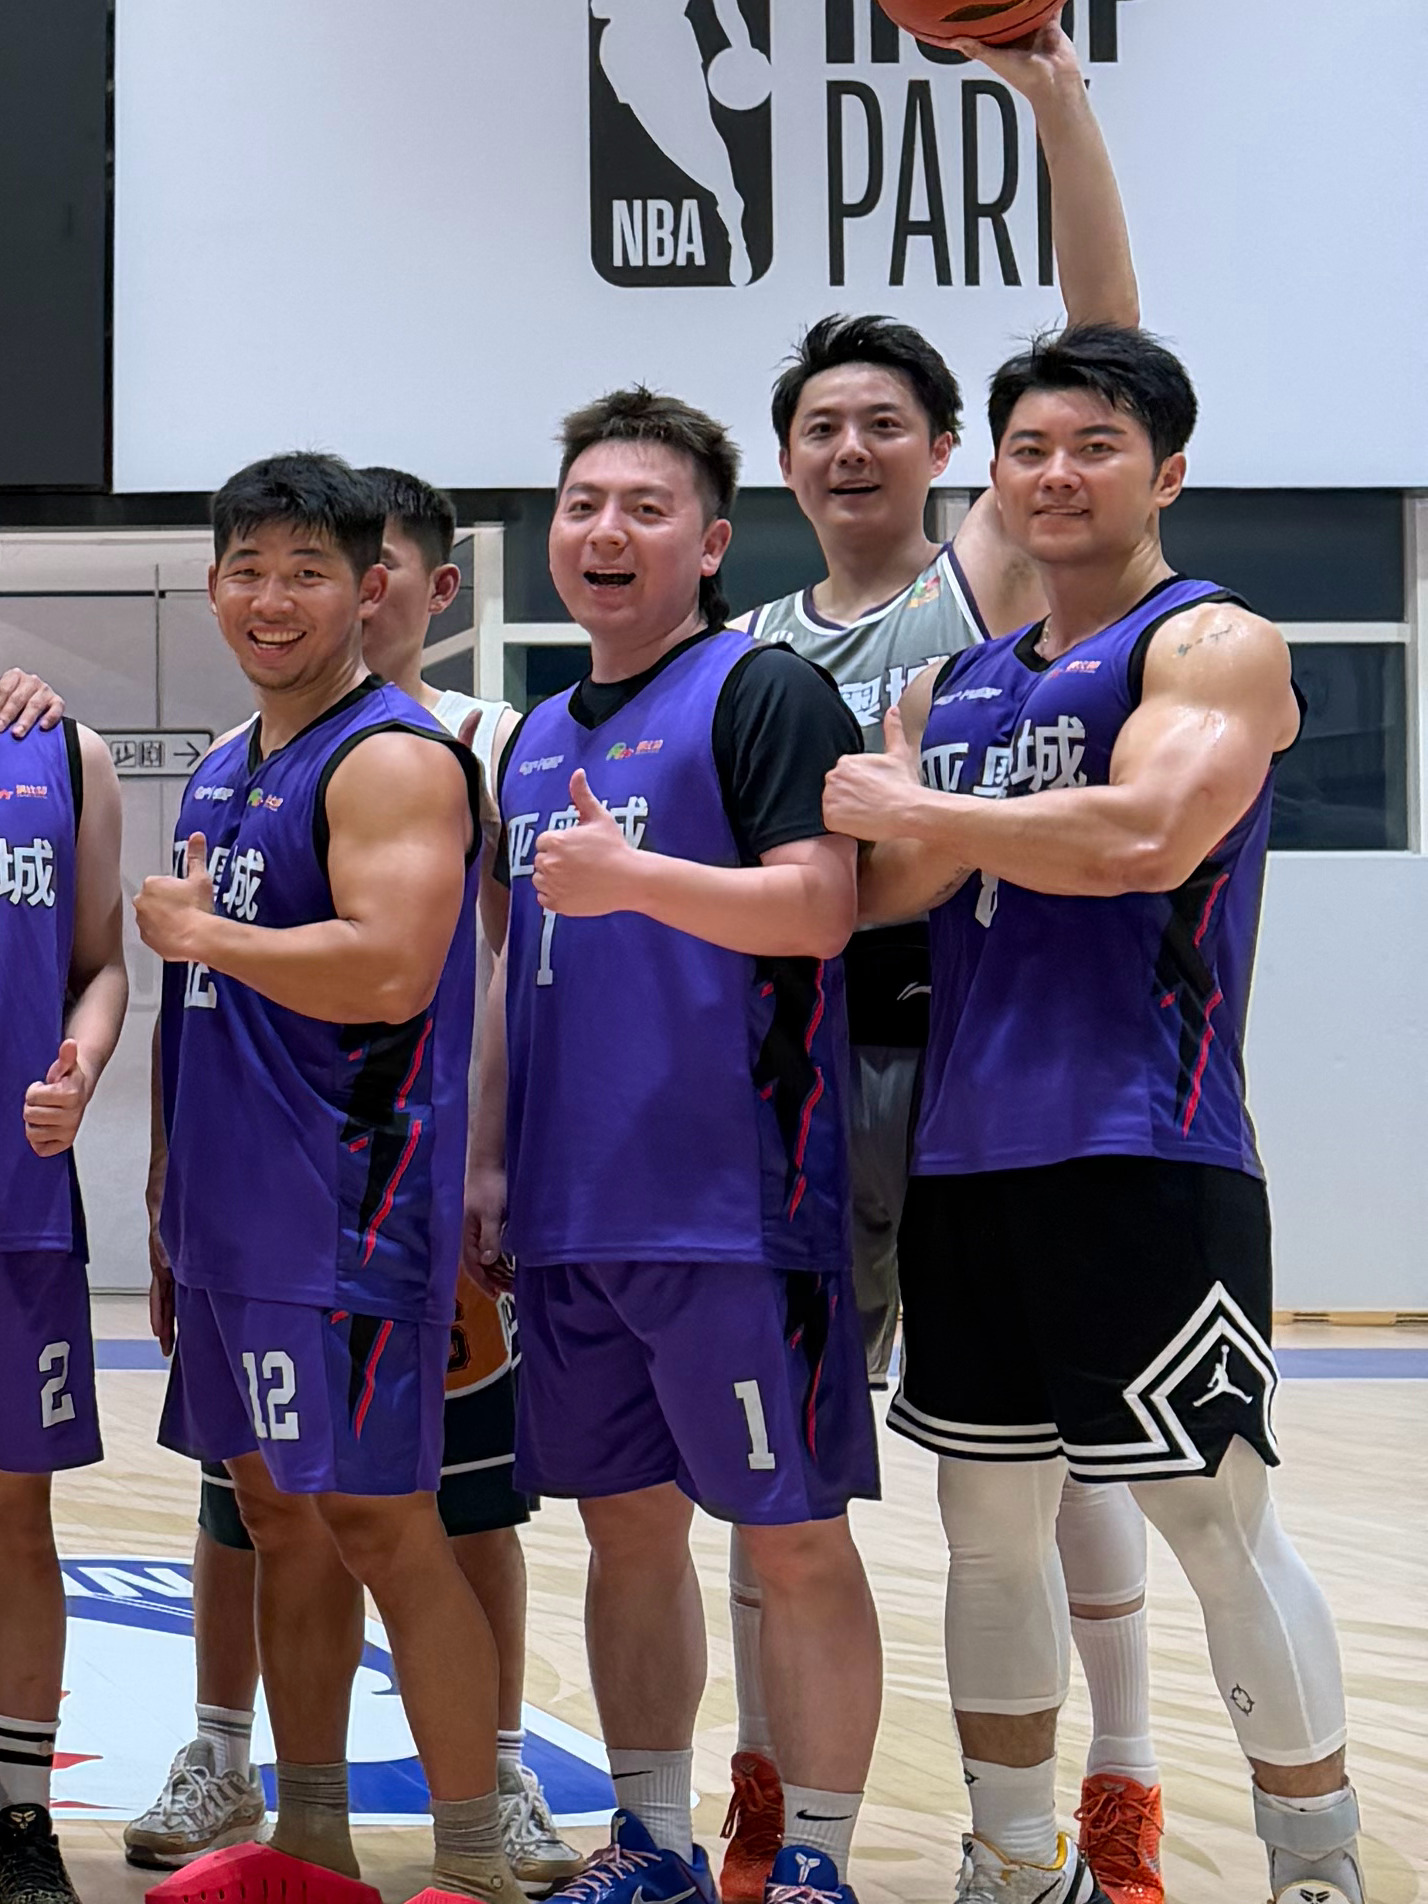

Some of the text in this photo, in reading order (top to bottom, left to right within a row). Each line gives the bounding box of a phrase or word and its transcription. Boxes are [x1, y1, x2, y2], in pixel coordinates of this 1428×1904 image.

[611, 199, 706, 267] NBA
[37, 1341, 77, 1429] 2
[242, 1351, 300, 1440] 12
[734, 1380, 776, 1469] 1
